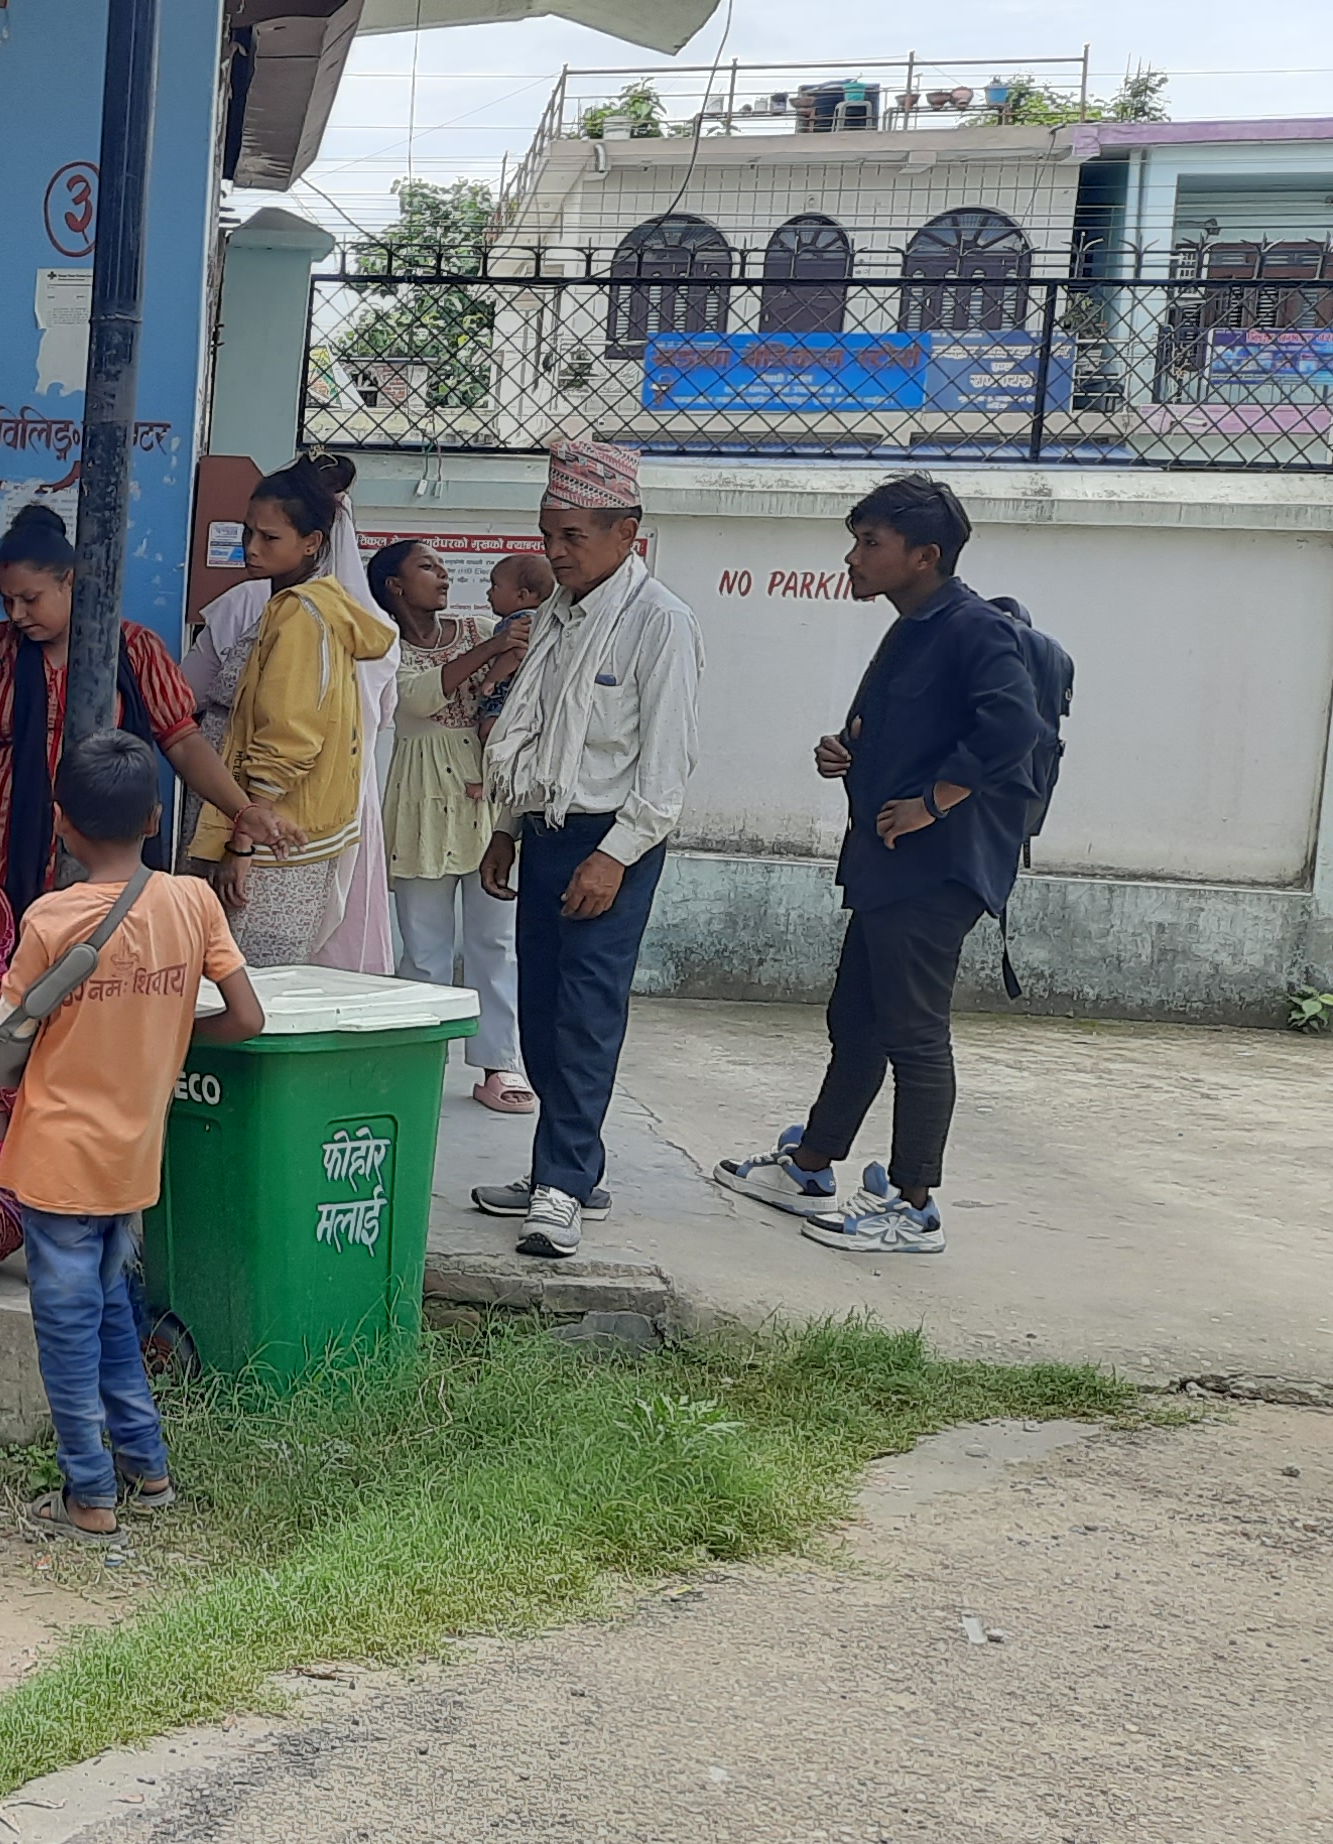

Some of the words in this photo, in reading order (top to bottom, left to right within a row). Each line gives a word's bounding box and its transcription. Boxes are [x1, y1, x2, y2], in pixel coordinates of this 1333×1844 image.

[719, 570, 752, 597] NO
[133, 962, 188, 998] शिवाय
[323, 1126, 392, 1193] फोहोर
[317, 1184, 388, 1258] मलाई
